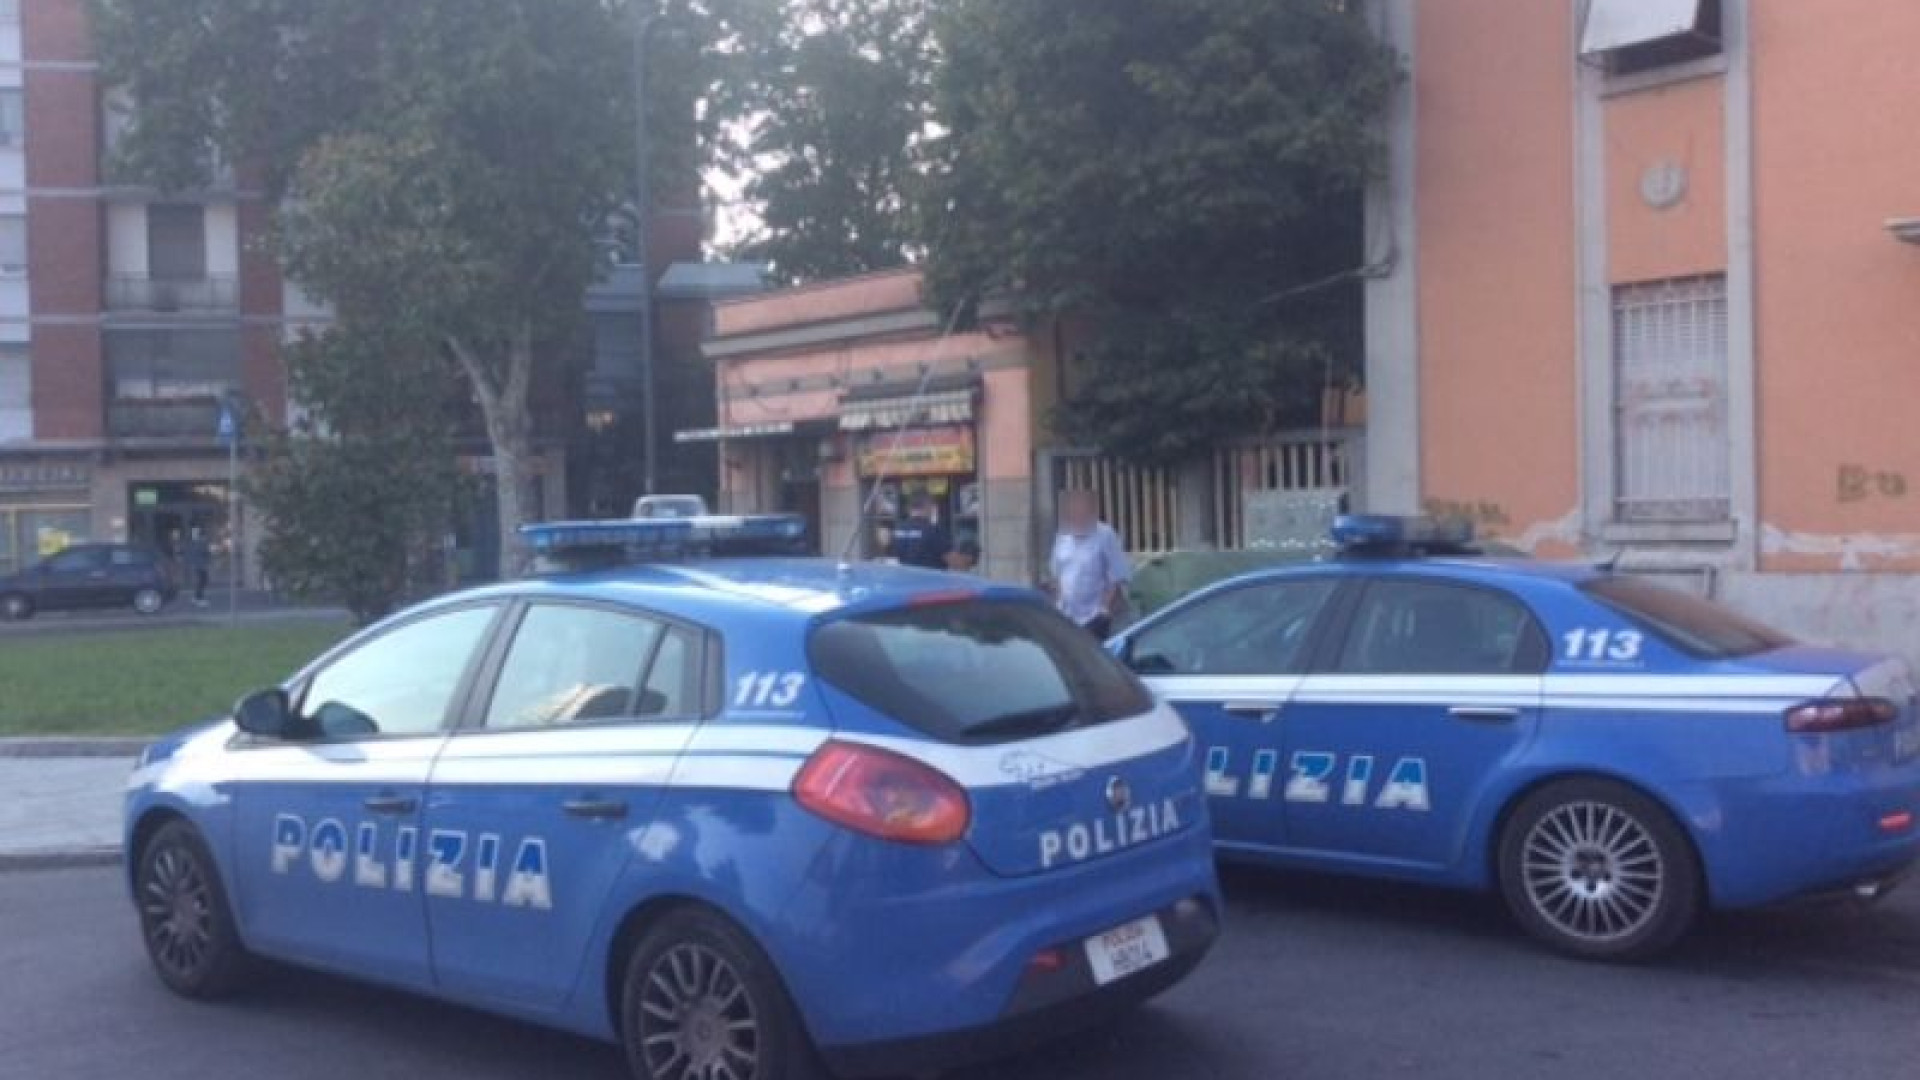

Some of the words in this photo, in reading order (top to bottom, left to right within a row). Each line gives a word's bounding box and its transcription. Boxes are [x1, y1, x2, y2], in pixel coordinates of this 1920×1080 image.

[1562, 628, 1644, 660] 113
[734, 671, 805, 706] 113
[1039, 798, 1179, 868] POLIZIA
[271, 813, 552, 909] POLIZIA
